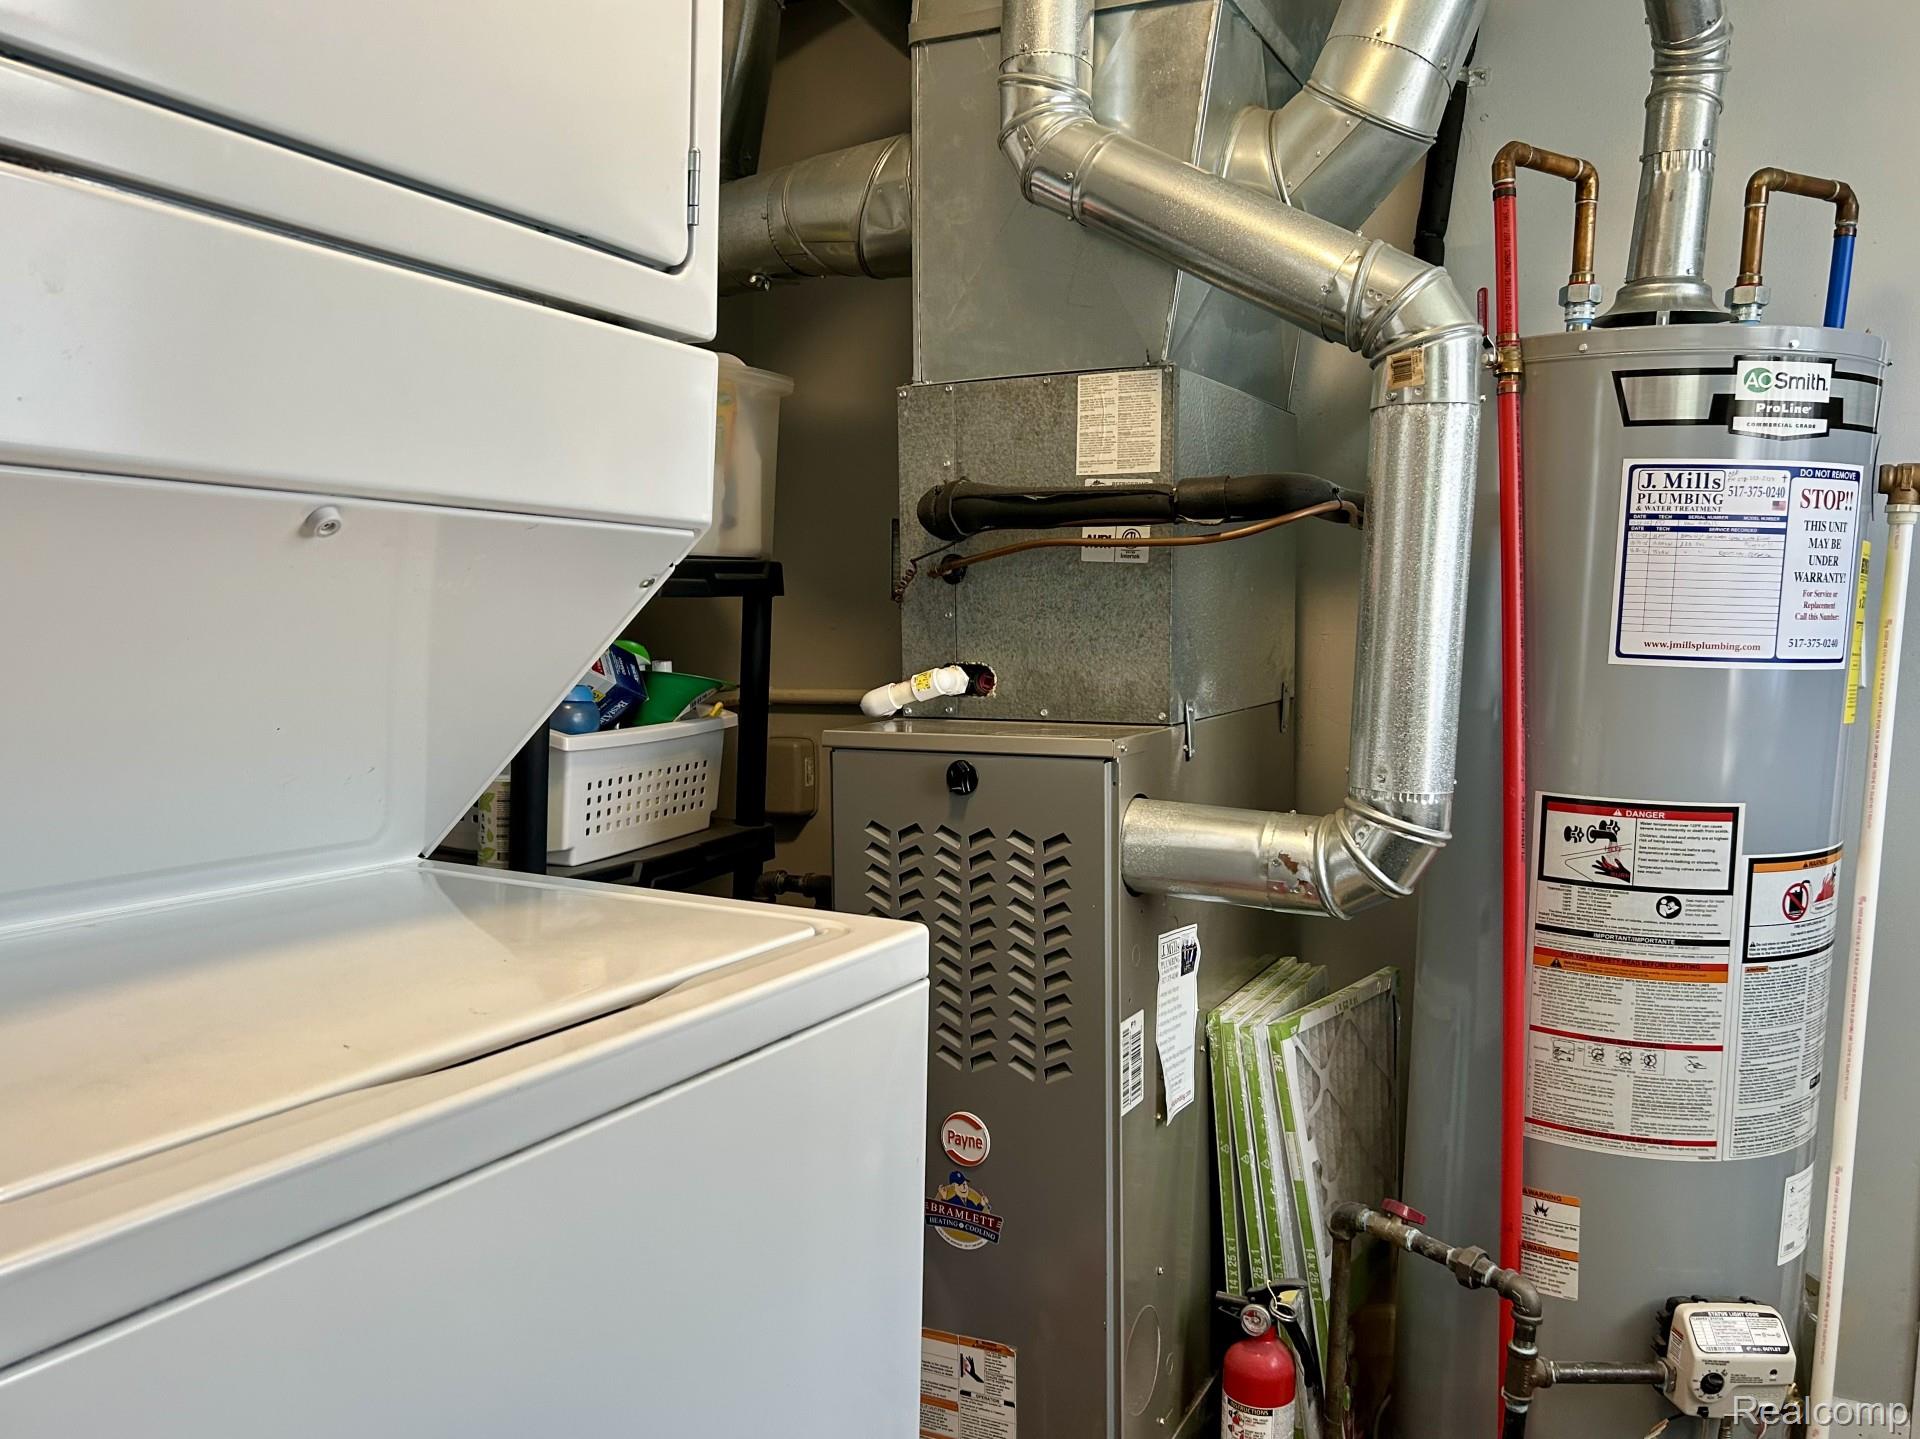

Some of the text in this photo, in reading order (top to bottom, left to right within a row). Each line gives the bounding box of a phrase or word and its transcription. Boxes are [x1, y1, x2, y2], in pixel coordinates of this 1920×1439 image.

[1745, 371, 1774, 389] AO
[1755, 402, 1811, 414] ProLine
[1641, 472, 1657, 489] J.
[1663, 472, 1721, 489] Mills
[1800, 469, 1856, 480] DO NOT REMOVE
[1728, 485, 1786, 498] 517-375-0240
[1637, 493, 1724, 505] PLUMBING
[1800, 488, 1853, 511] STOP!!
[1675, 505, 1722, 513] TREATMENT
[1804, 520, 1848, 532] THIS UNIT
[1808, 538, 1841, 549] MAY BE
[1808, 555, 1839, 566] UNDER
[1794, 572, 1847, 583] WARRANTY!
[1802, 590, 1813, 598] For
[1803, 601, 1836, 610] Replacement
[1644, 640, 1761, 652] www.jmillsplumbing.com
[1788, 638, 1839, 648] 517-375-0240
[1625, 809, 1665, 819] DANGER
[1593, 932, 1676, 945] IMPORTANT/IMPORTANTE
[947, 1130, 983, 1150] Payne
[1527, 1189, 1562, 1202] WARNING
[930, 1202, 995, 1228] BRAMLETT
[929, 1216, 959, 1227] HEATING
[964, 1224, 996, 1241] COOLING
[1305, 1247, 1316, 1259] 14
[1527, 1243, 1561, 1257] WARNING
[1227, 1255, 1237, 1268] 25
[1253, 1266, 1263, 1279] 25
[1308, 1271, 1319, 1283] 25
[1229, 1281, 1239, 1290] 14
[1229, 1400, 1269, 1416] INSTRUCTIONS
